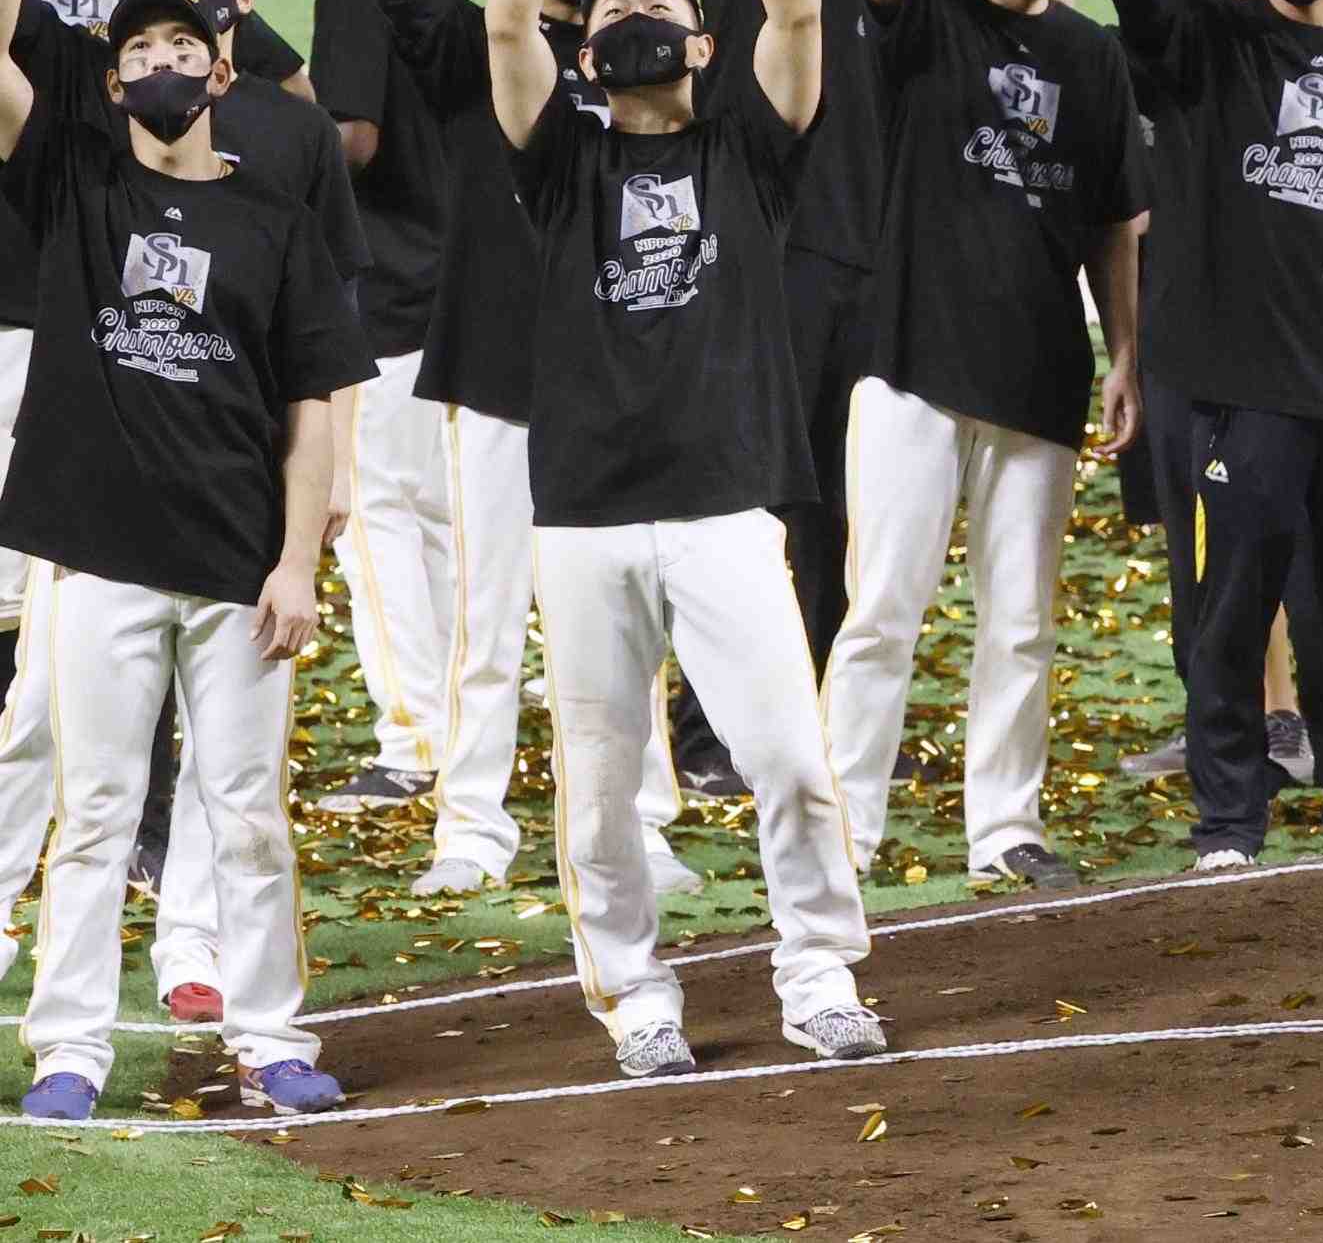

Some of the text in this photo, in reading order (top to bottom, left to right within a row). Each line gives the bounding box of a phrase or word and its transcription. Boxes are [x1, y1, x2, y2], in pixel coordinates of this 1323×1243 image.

[633, 234, 688, 253] NIPPON
[172, 287, 197, 306] V4
[133, 300, 187, 319] NIPPON
[139, 318, 180, 333] 2020
[91, 307, 237, 366] Champions
